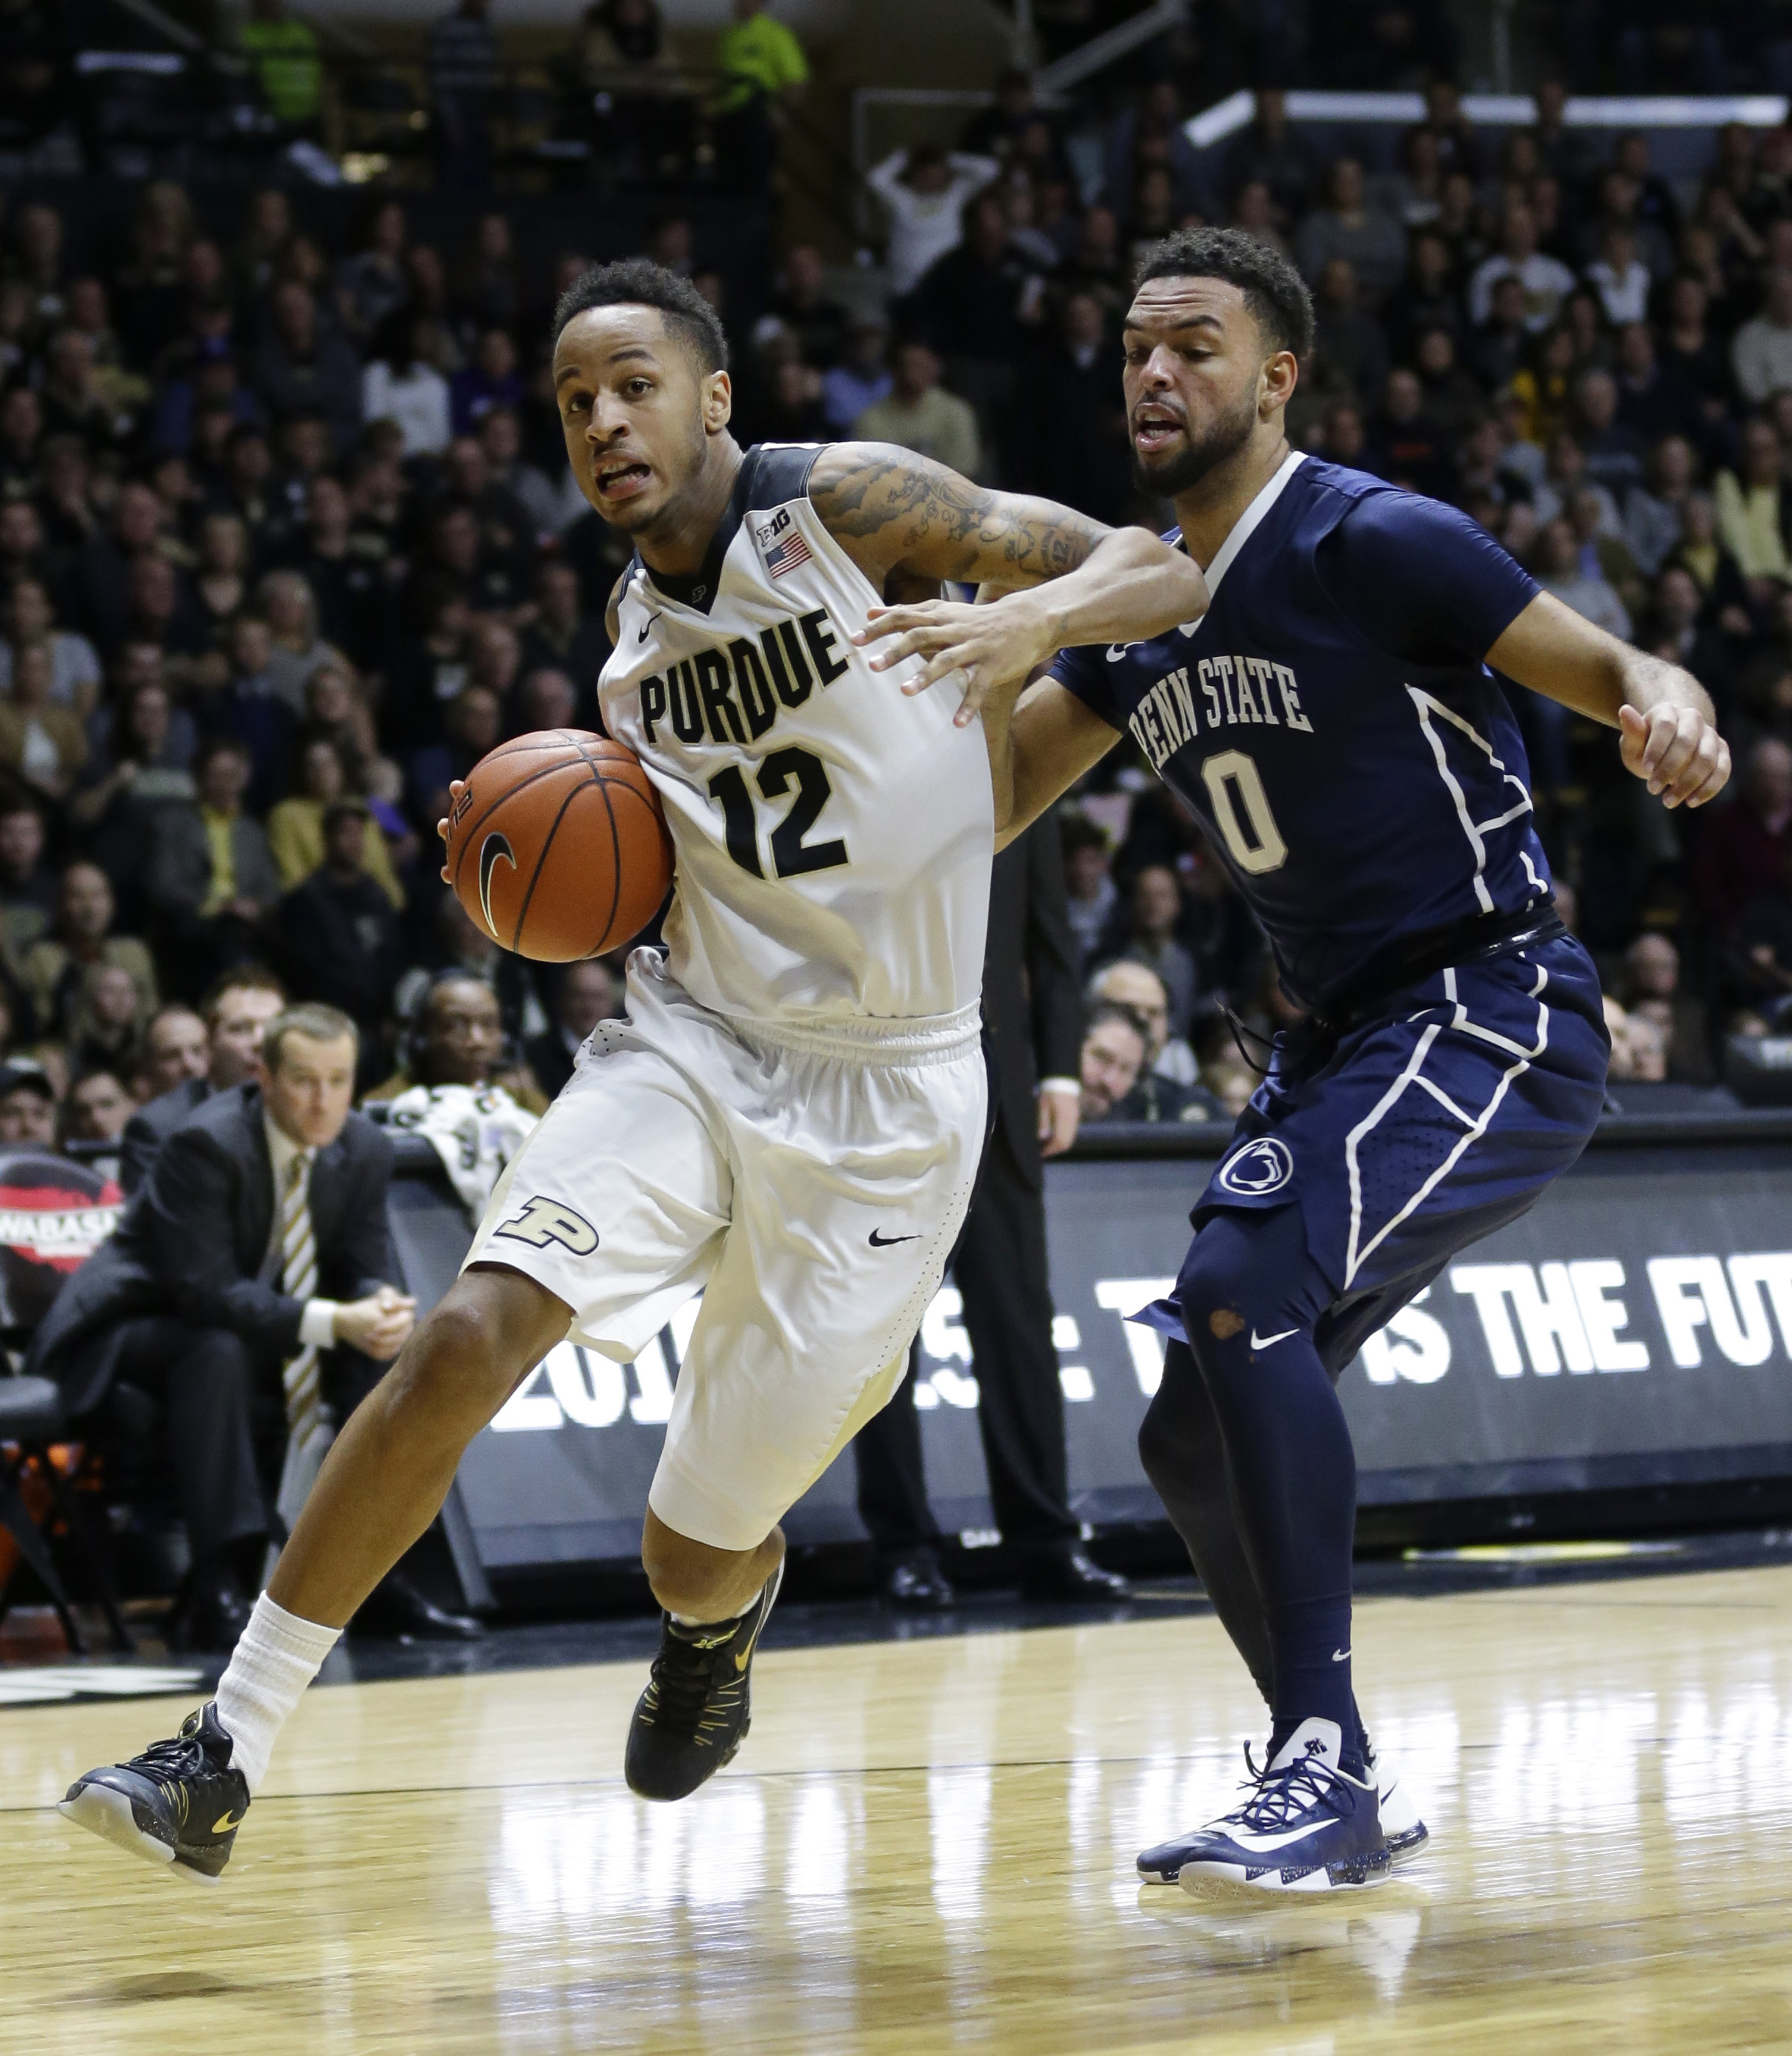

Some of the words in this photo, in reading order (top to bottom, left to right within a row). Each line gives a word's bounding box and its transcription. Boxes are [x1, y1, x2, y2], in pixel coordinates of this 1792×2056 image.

[639, 607, 850, 744] PURDUE
[1199, 655, 1314, 732] STATE
[707, 746, 852, 881] 12
[1201, 749, 1288, 875] 0
[493, 1195, 599, 1256] P
[1449, 1258, 1651, 1377] THE
